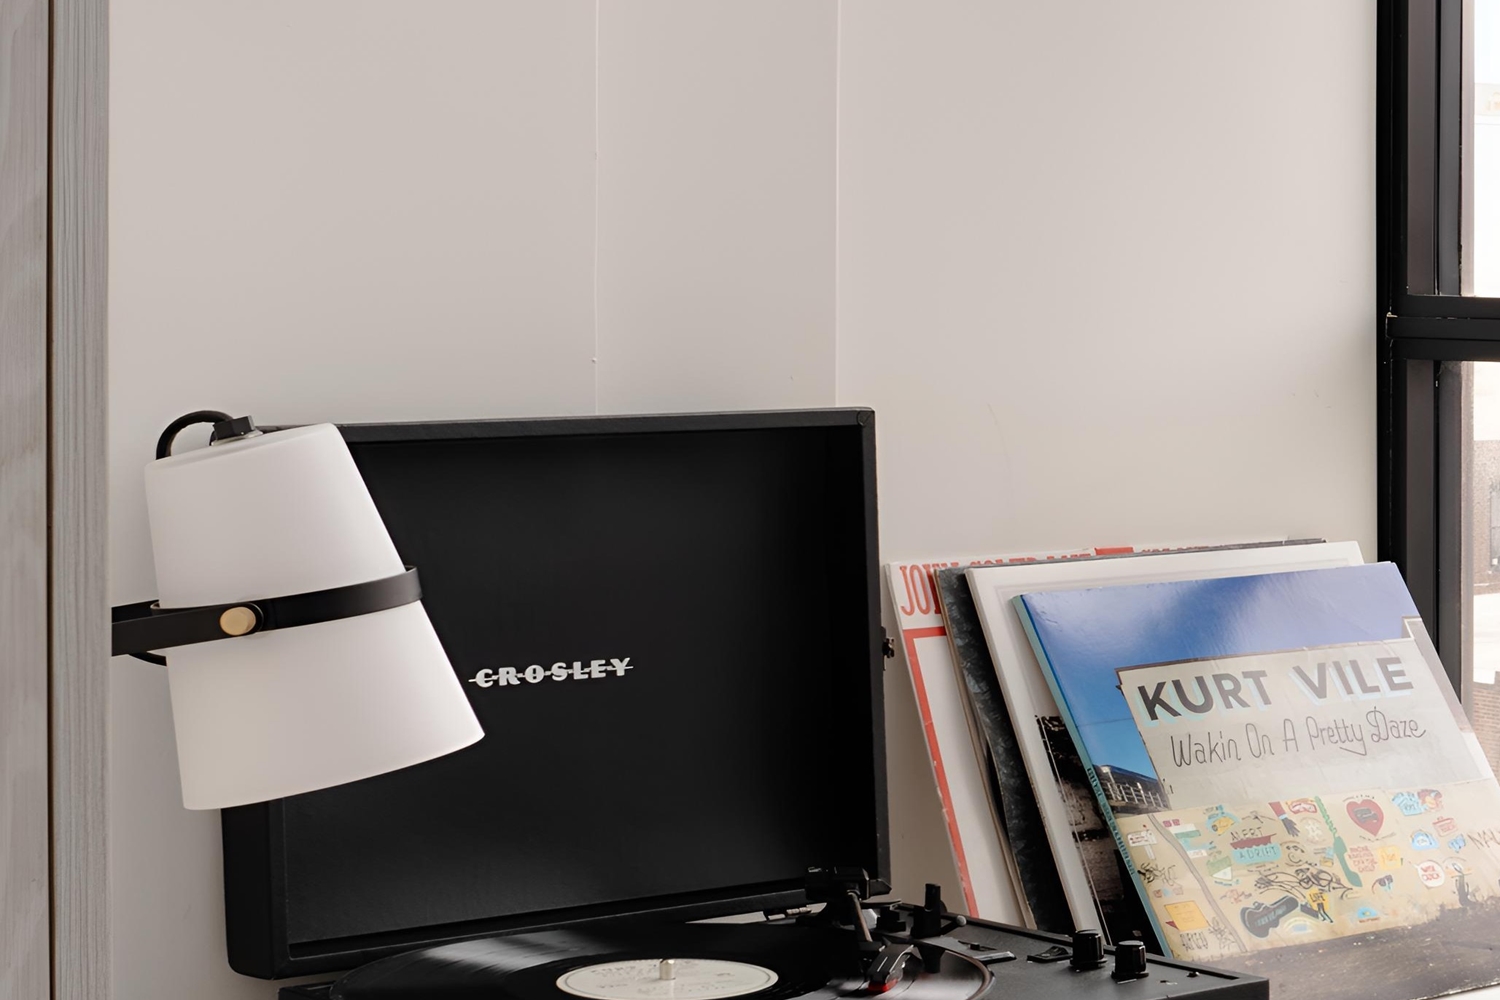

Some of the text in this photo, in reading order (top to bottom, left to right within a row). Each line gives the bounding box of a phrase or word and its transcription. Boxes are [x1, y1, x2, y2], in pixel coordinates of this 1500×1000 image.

[469, 657, 633, 688] CROSLEY
[1136, 657, 1414, 722] KURT VILE
[1170, 706, 1426, 768] Wakin On A Pretty Daze
